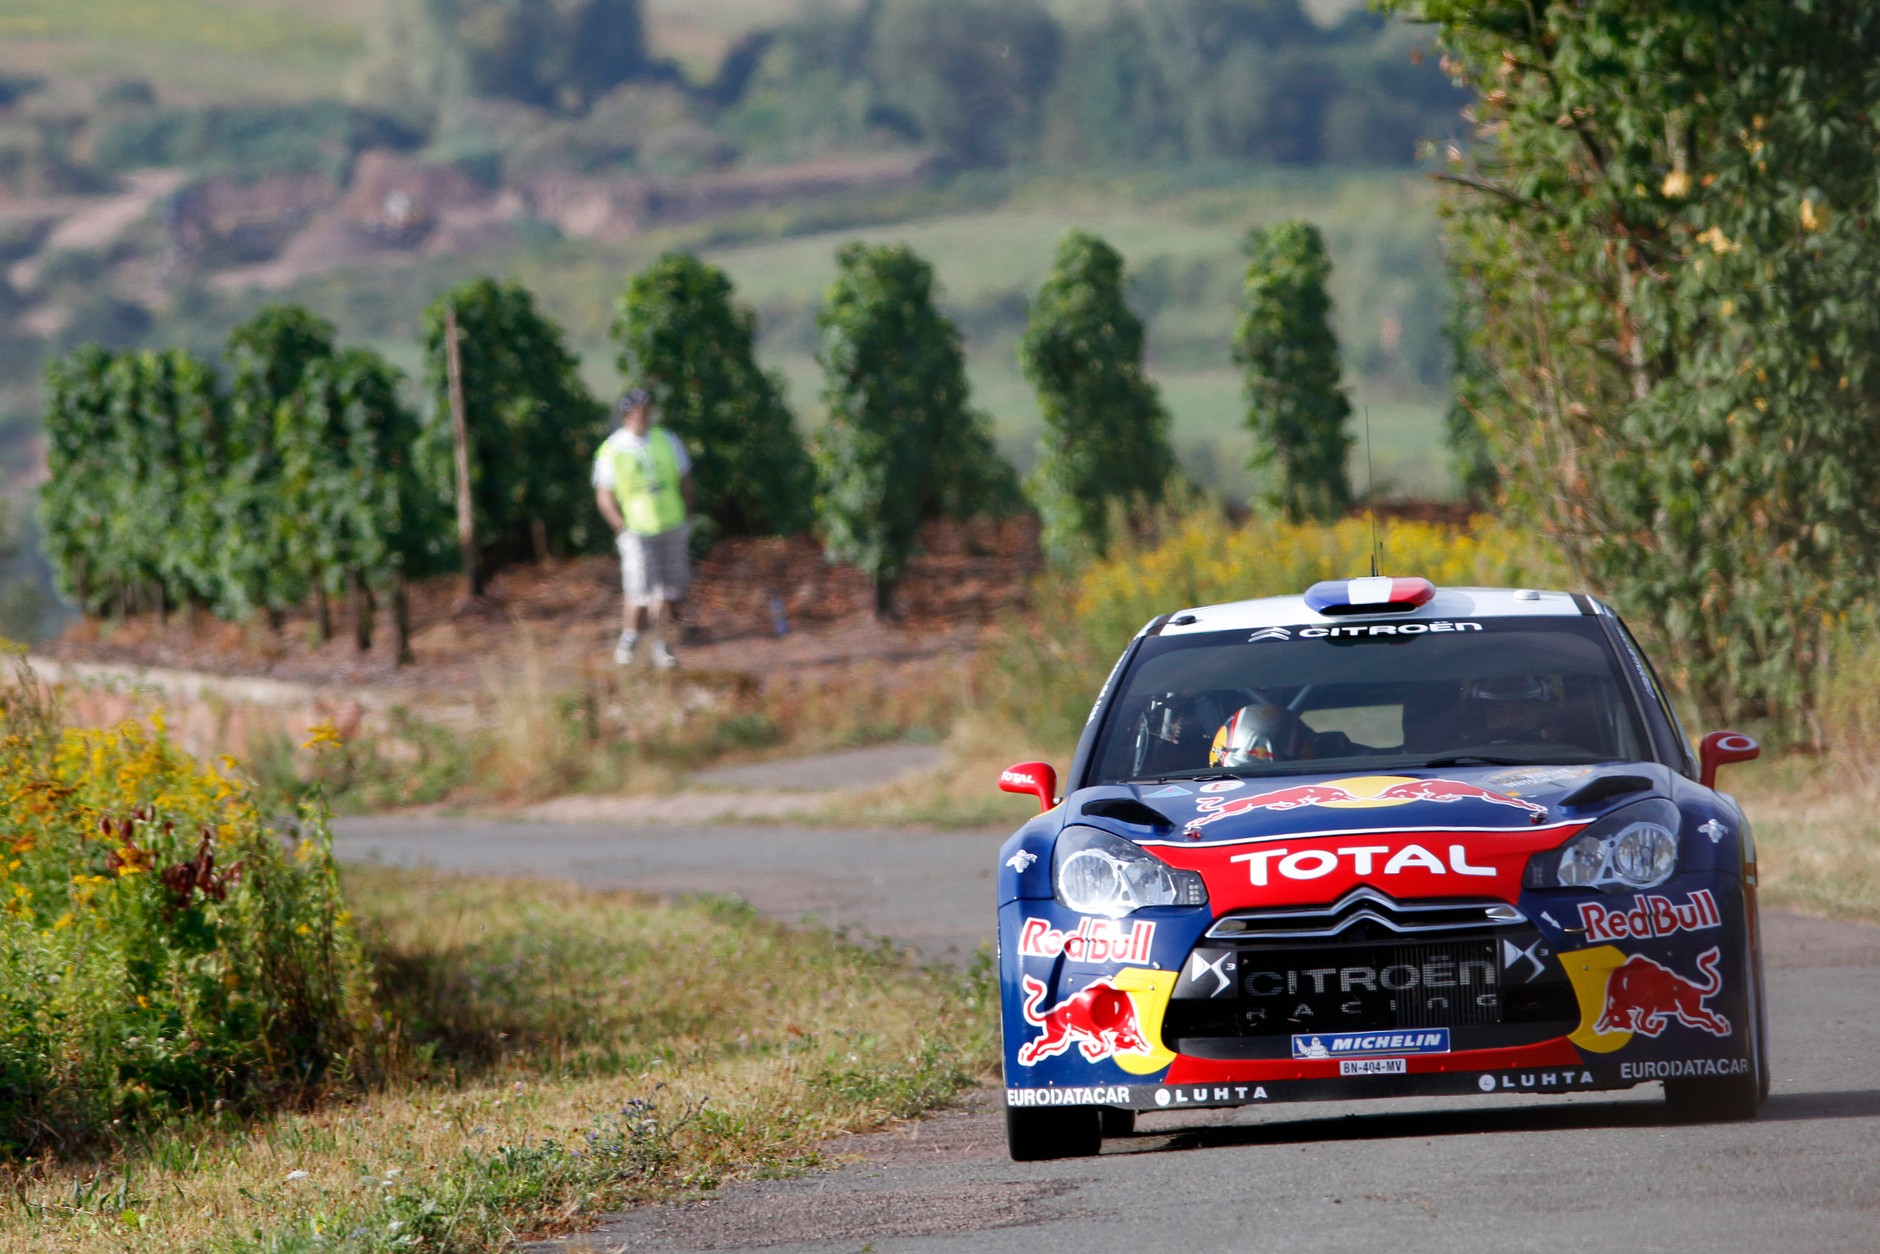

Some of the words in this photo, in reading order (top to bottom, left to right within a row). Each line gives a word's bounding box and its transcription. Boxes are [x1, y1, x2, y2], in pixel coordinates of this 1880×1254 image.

[1001, 771, 1035, 784] TOTAL
[1230, 844, 1497, 886] TOTAL
[1577, 894, 1653, 942] Red
[1647, 889, 1721, 938] Bull
[1018, 916, 1091, 962] Red
[1087, 918, 1156, 965] Bull
[1332, 1033, 1441, 1050] MICHELIN
[1343, 1060, 1402, 1074] BN-404-MV
[1620, 1058, 1749, 1079] EURODATACAR
[1502, 1071, 1594, 1087] LUHTA
[1007, 1087, 1130, 1106] EURODATACAR
[1175, 1086, 1268, 1102] LUHTA
